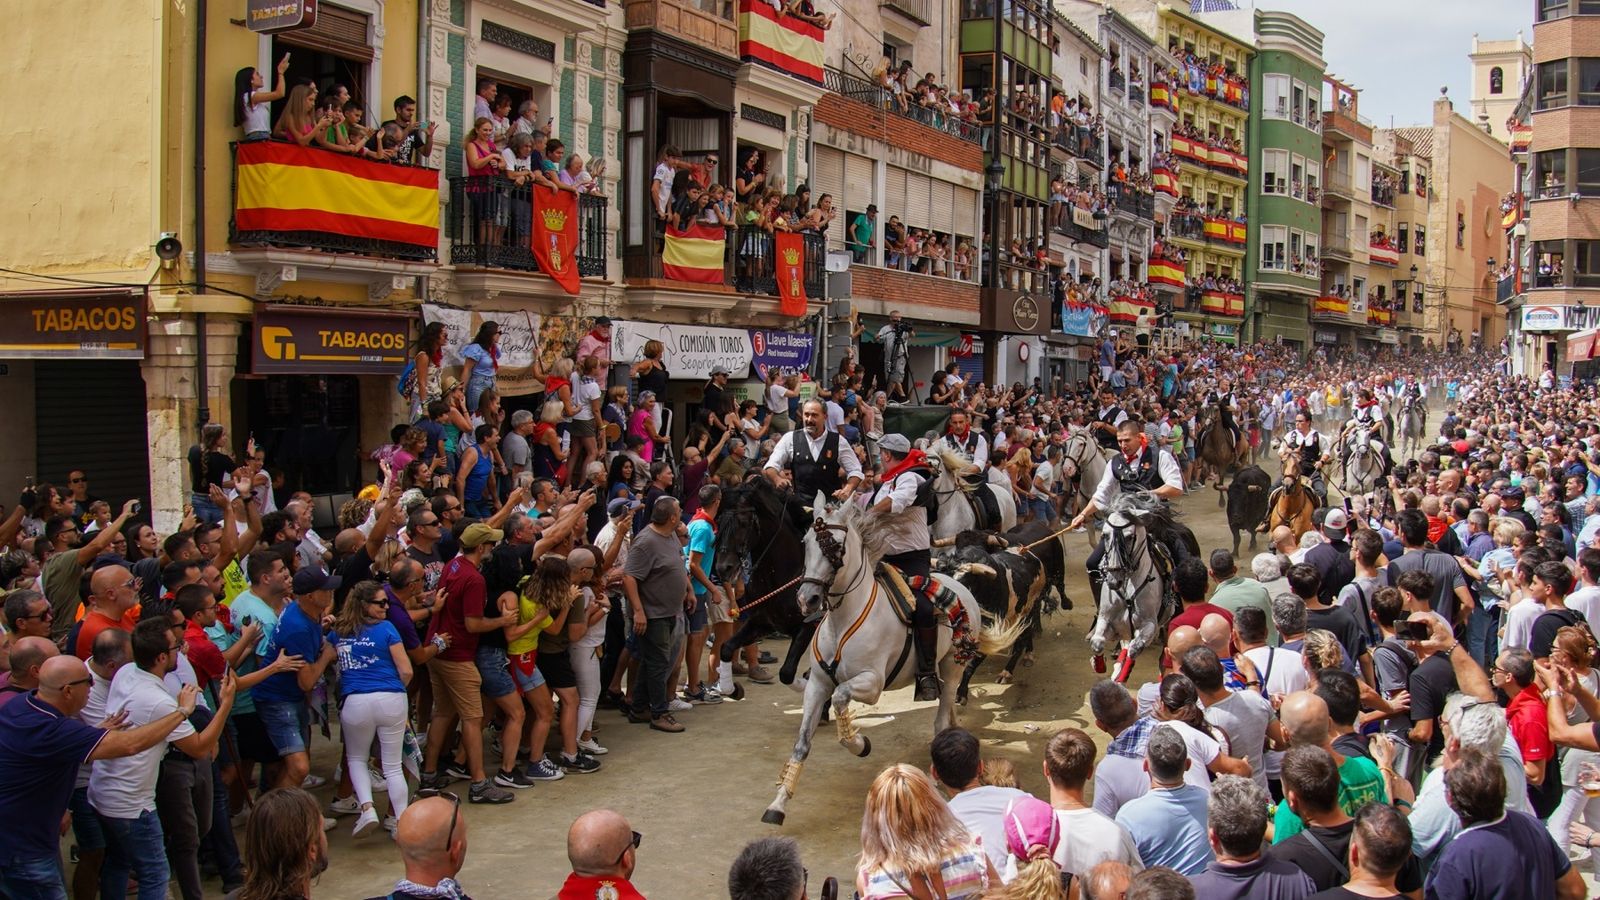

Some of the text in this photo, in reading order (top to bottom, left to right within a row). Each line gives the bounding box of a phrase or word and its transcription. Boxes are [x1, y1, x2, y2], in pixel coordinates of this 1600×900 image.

[251, 3, 298, 22] TABACOS
[32, 306, 136, 332] TABACOS
[318, 330, 405, 349] TABACOS
[680, 330, 744, 353] COMISIÓN TOROS
[767, 332, 787, 346] Llave
[681, 354, 717, 375] Segorbe
[719, 356, 747, 371] 2023
